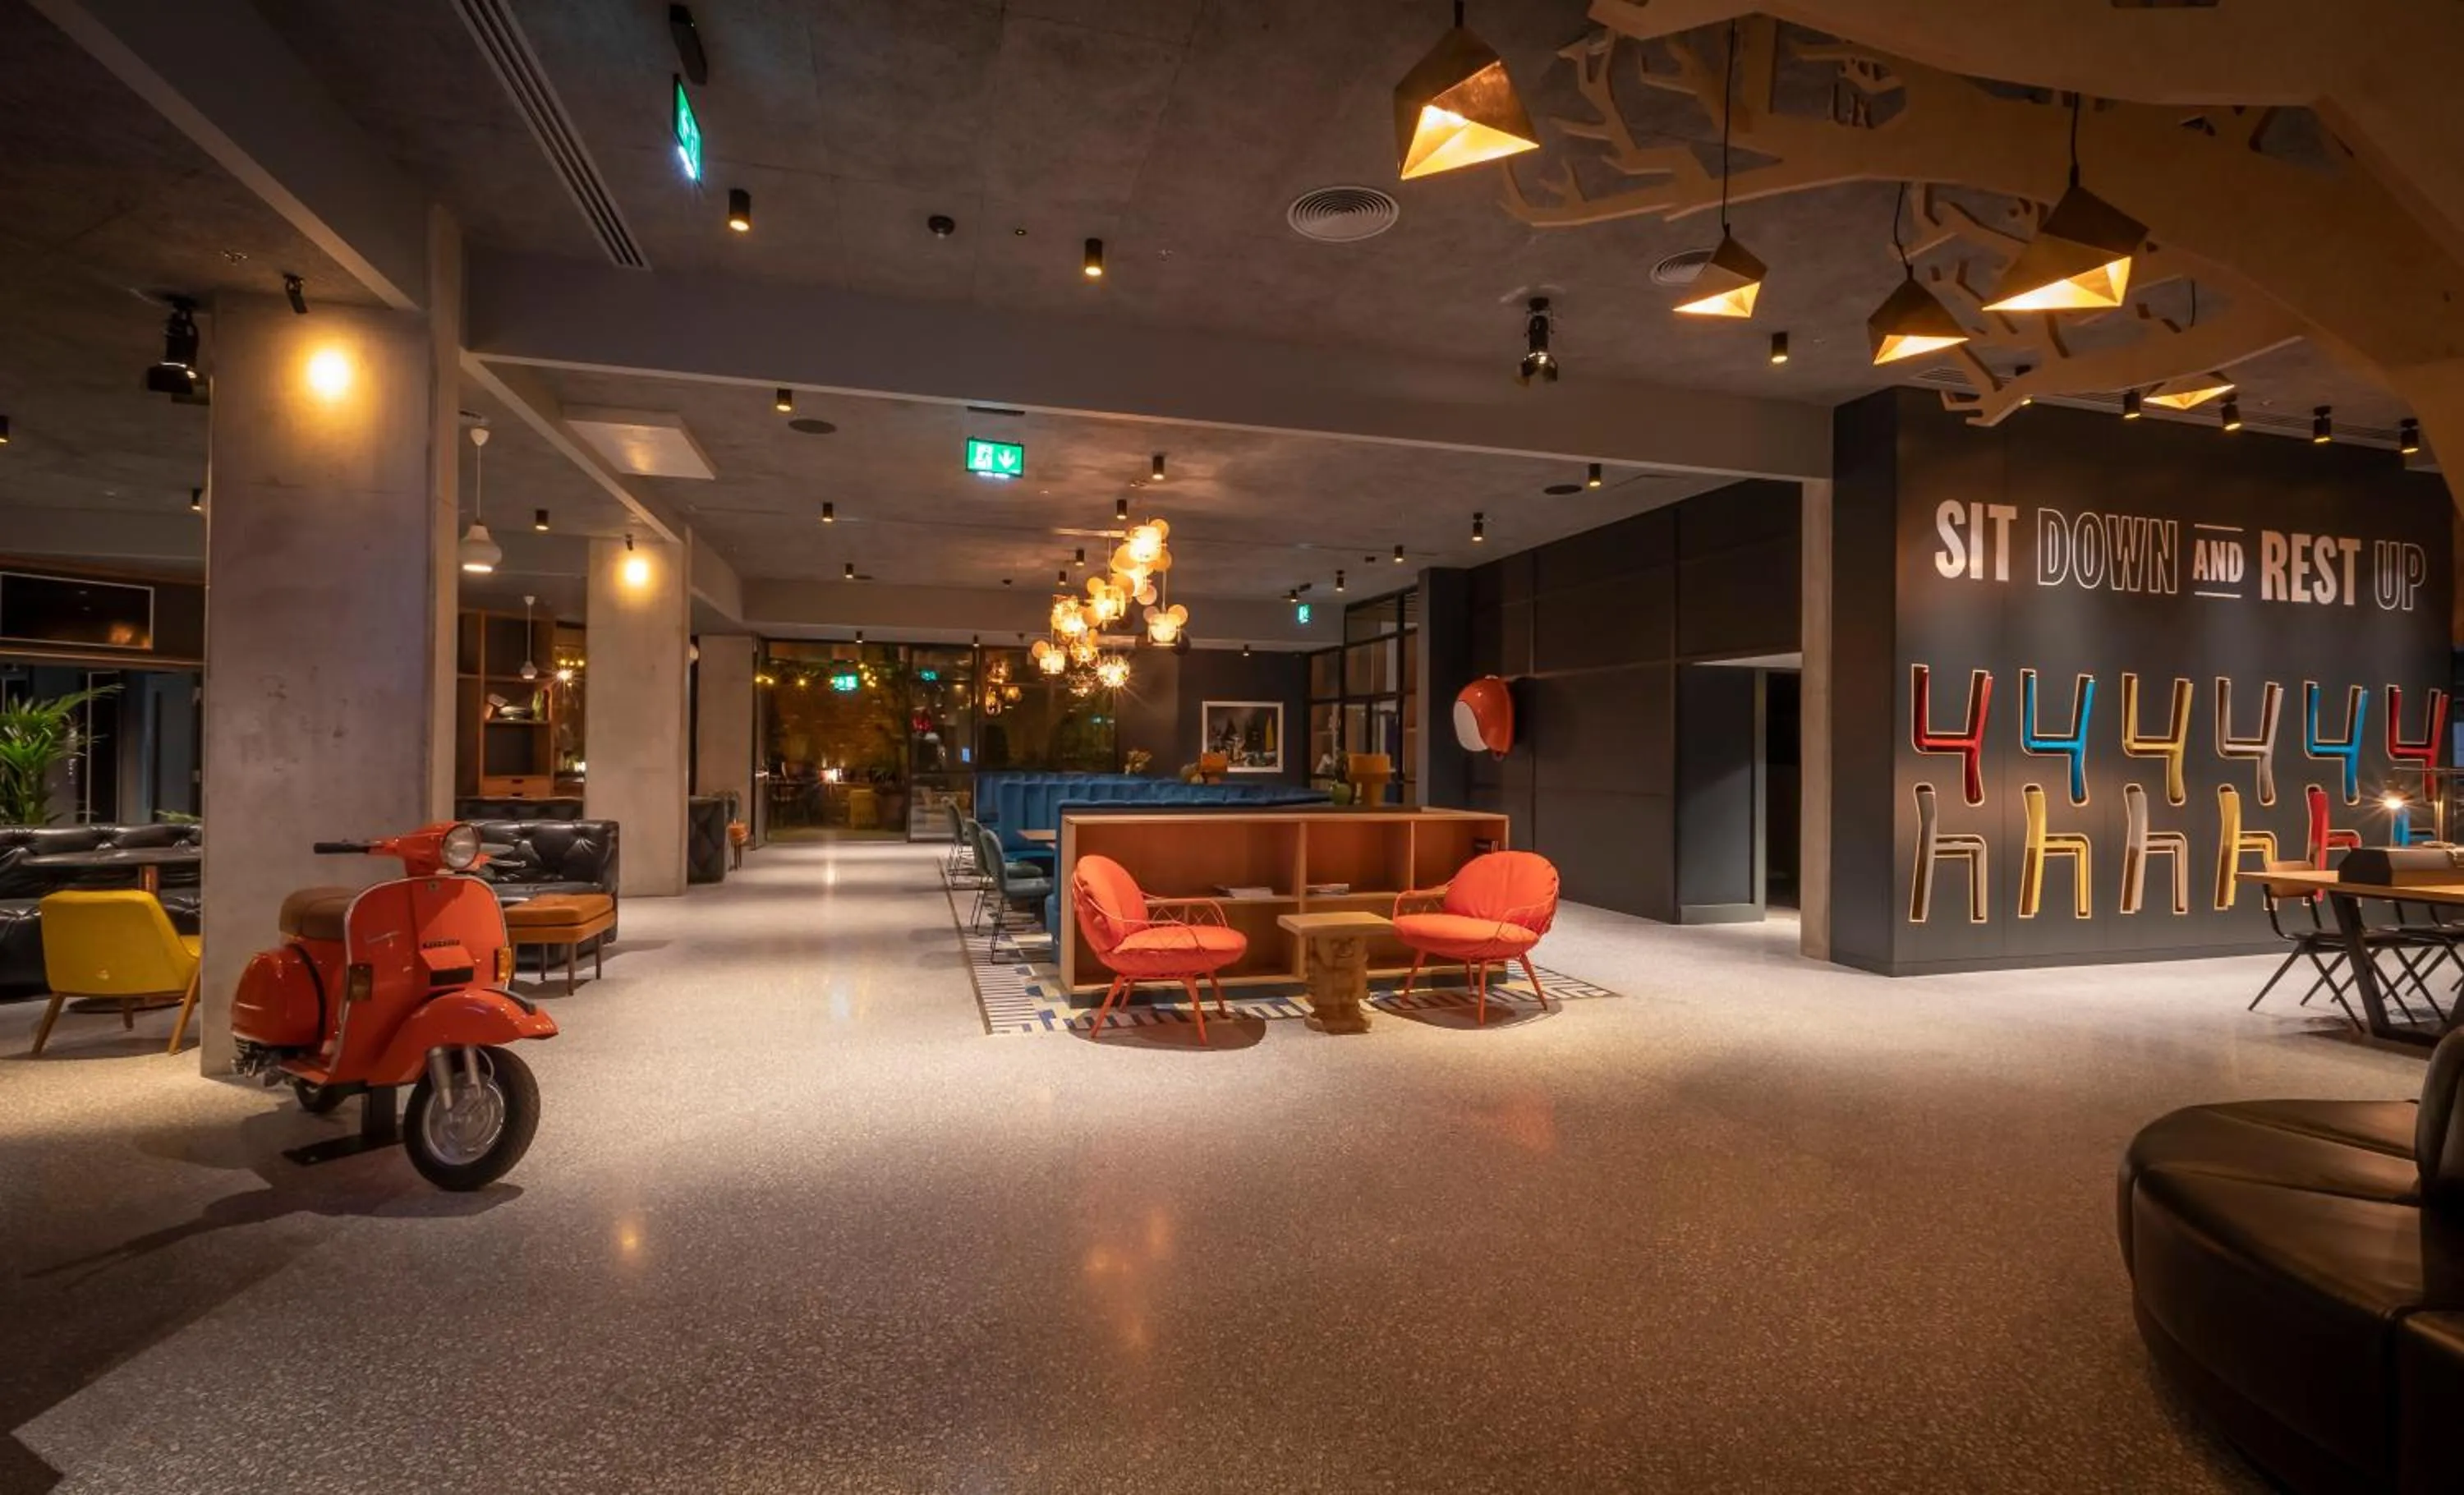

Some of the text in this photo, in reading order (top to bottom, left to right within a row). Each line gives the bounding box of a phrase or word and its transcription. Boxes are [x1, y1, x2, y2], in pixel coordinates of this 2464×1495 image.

[1935, 499, 2425, 611] SIT DOWN AND REST UP
